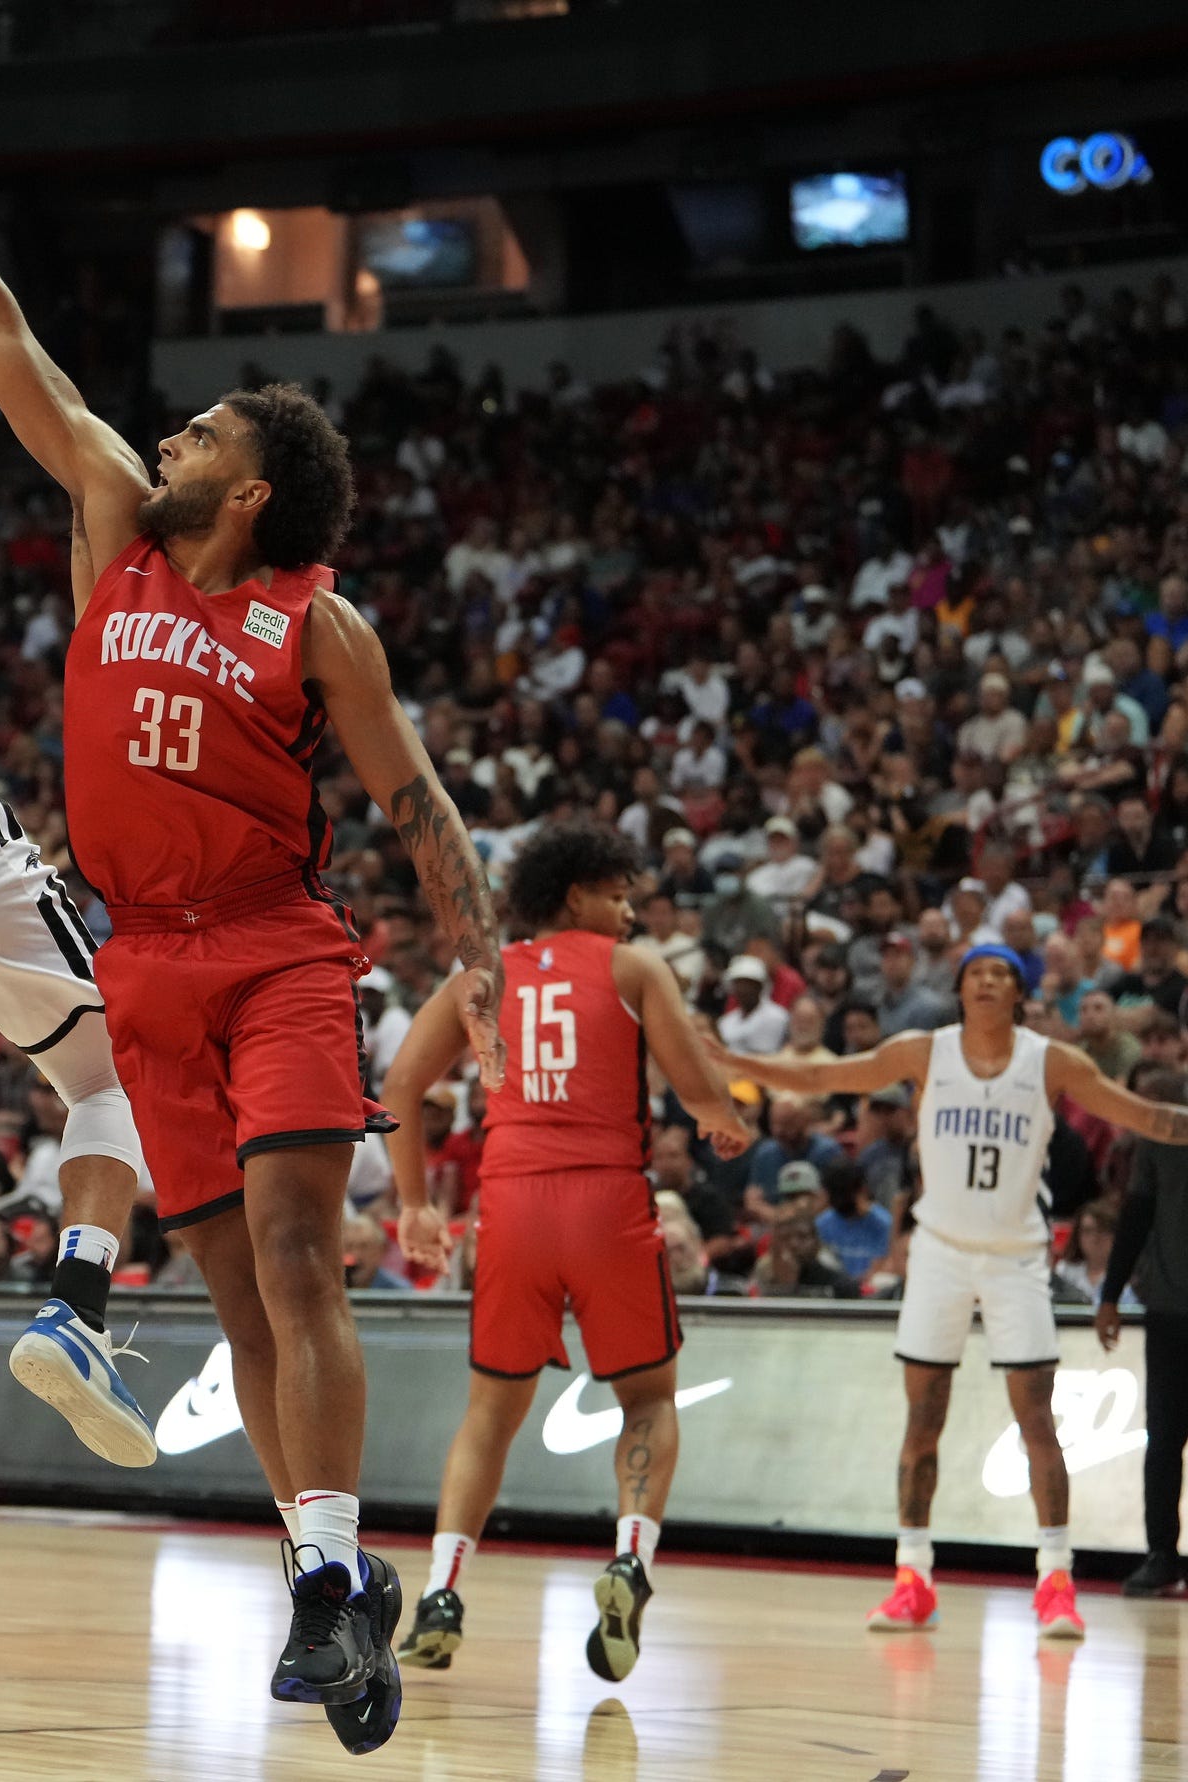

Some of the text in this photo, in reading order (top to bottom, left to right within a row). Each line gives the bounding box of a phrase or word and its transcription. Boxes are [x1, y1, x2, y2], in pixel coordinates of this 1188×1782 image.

[244, 616, 283, 645] karma
[252, 608, 286, 631] credit
[101, 611, 256, 703] ROCKETS
[128, 688, 203, 772] 33
[517, 981, 577, 1072] 15
[522, 1070, 569, 1103] NIX
[934, 1105, 1031, 1147] MAGIC
[967, 1143, 1001, 1191] 13
